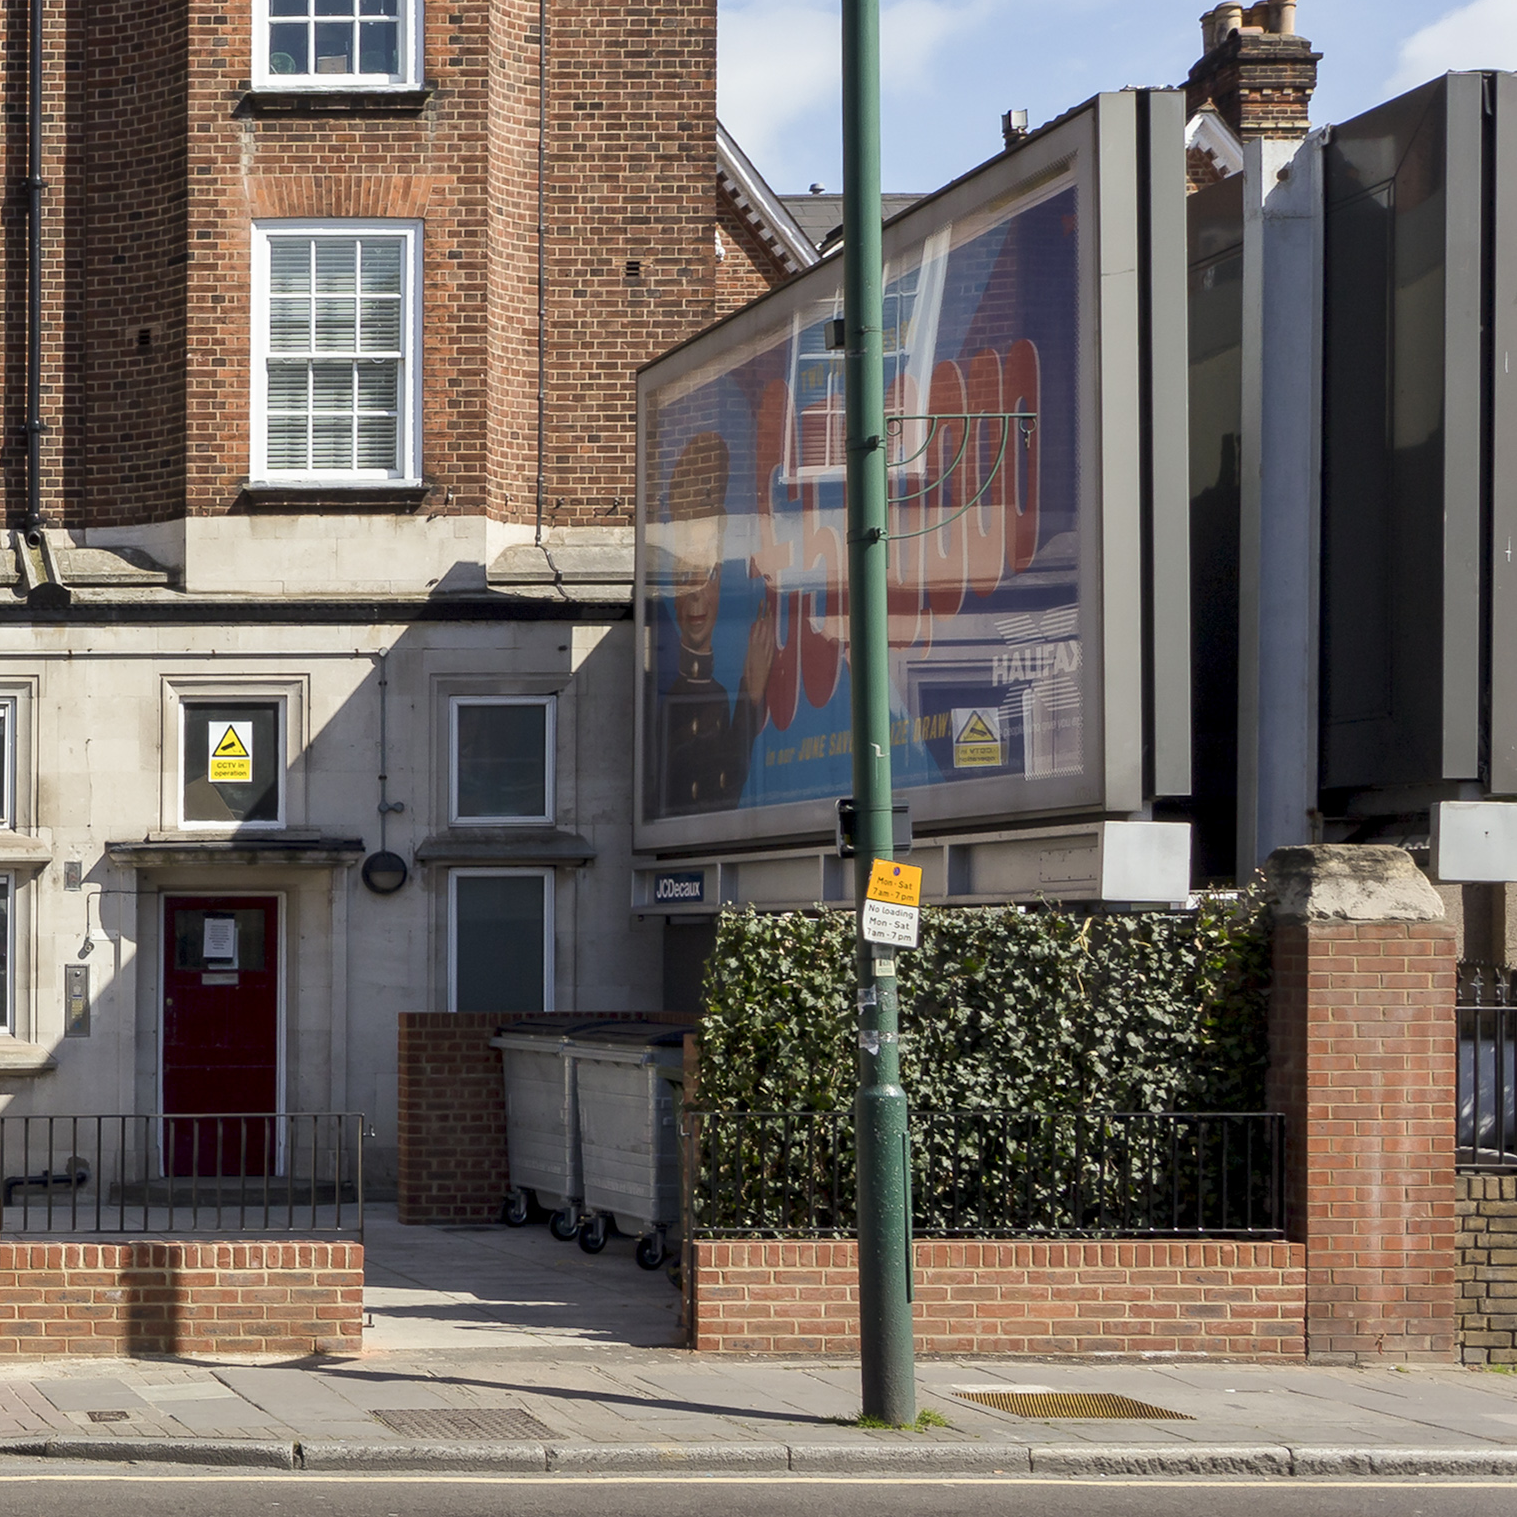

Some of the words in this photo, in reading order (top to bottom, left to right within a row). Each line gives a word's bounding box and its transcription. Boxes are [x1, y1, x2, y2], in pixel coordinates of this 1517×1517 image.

[751, 339, 1039, 731] £50,000
[992, 639, 1081, 687] HALIFAX
[798, 734, 826, 761] JUNE
[656, 878, 701, 898] JCDecaux
[876, 876, 893, 887] Mon
[898, 880, 913, 891] Sat
[868, 904, 880, 914] No
[882, 904, 914, 919] loading
[869, 916, 888, 927] Mon
[894, 920, 910, 931] Sat
